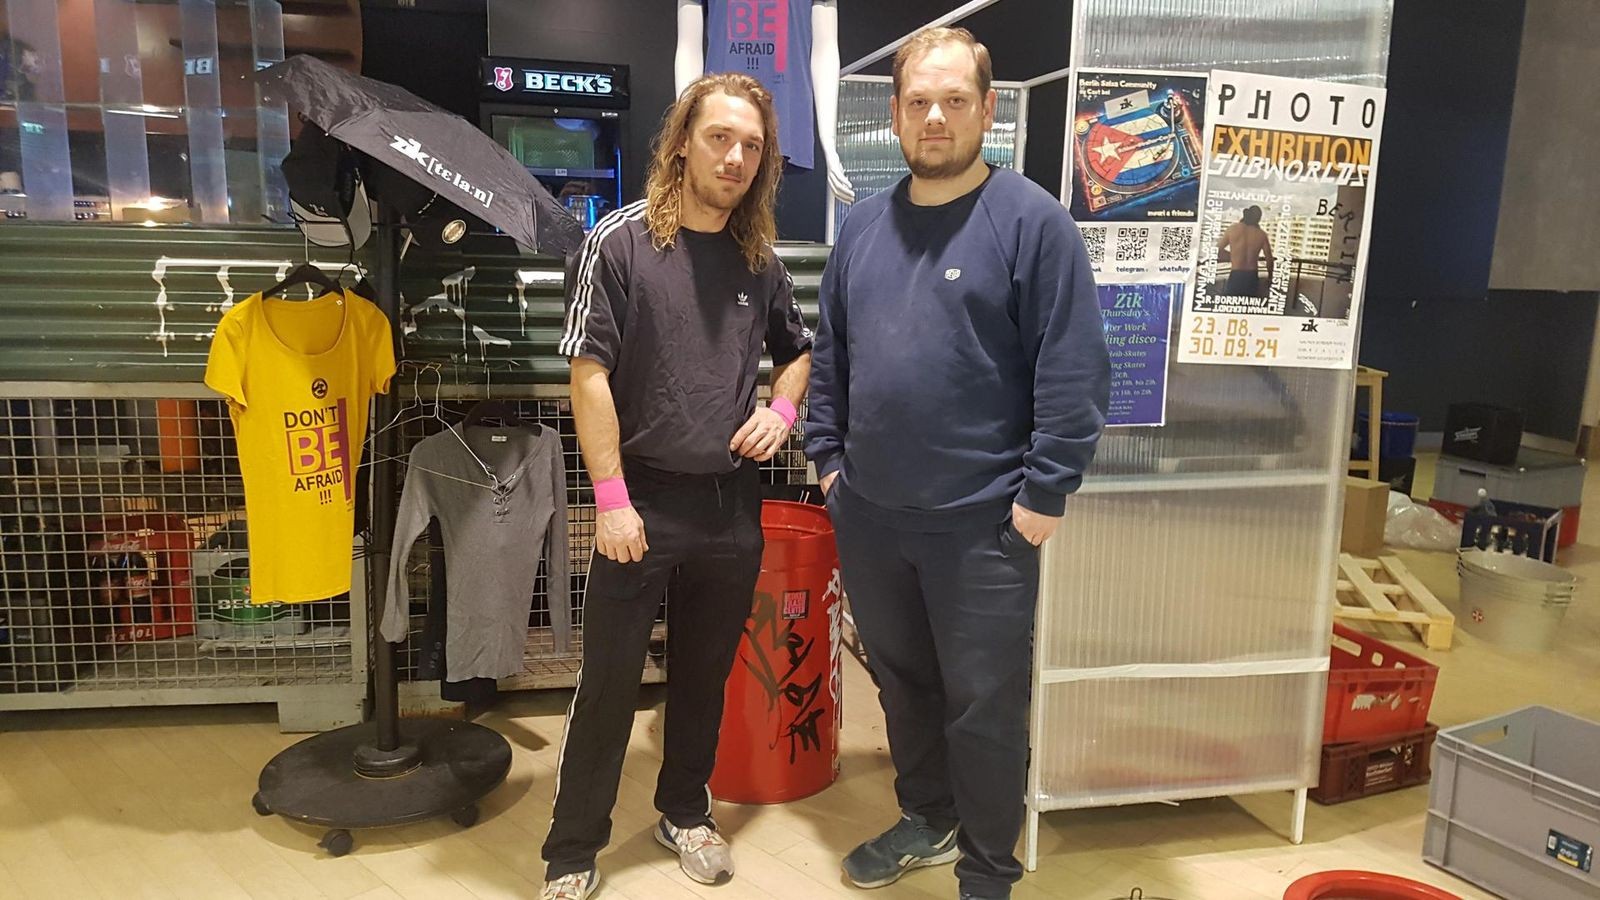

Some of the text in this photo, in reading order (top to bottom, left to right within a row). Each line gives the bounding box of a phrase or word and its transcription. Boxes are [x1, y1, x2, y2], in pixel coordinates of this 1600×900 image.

[729, 1, 777, 39] BE
[729, 42, 775, 55] AFRAID
[525, 72, 613, 94] BECK'S
[1120, 80, 1158, 90] Community
[1218, 84, 1376, 128] PHOTO
[1211, 126, 1372, 173] EXHIBITION
[1207, 153, 1371, 187] SUBWORLDS
[1113, 292, 1144, 309] Zik
[1124, 322, 1147, 331] Work
[1128, 333, 1157, 345] disco
[283, 405, 338, 429] DON'T
[288, 425, 343, 474] BE
[294, 469, 343, 492] AFRAID
